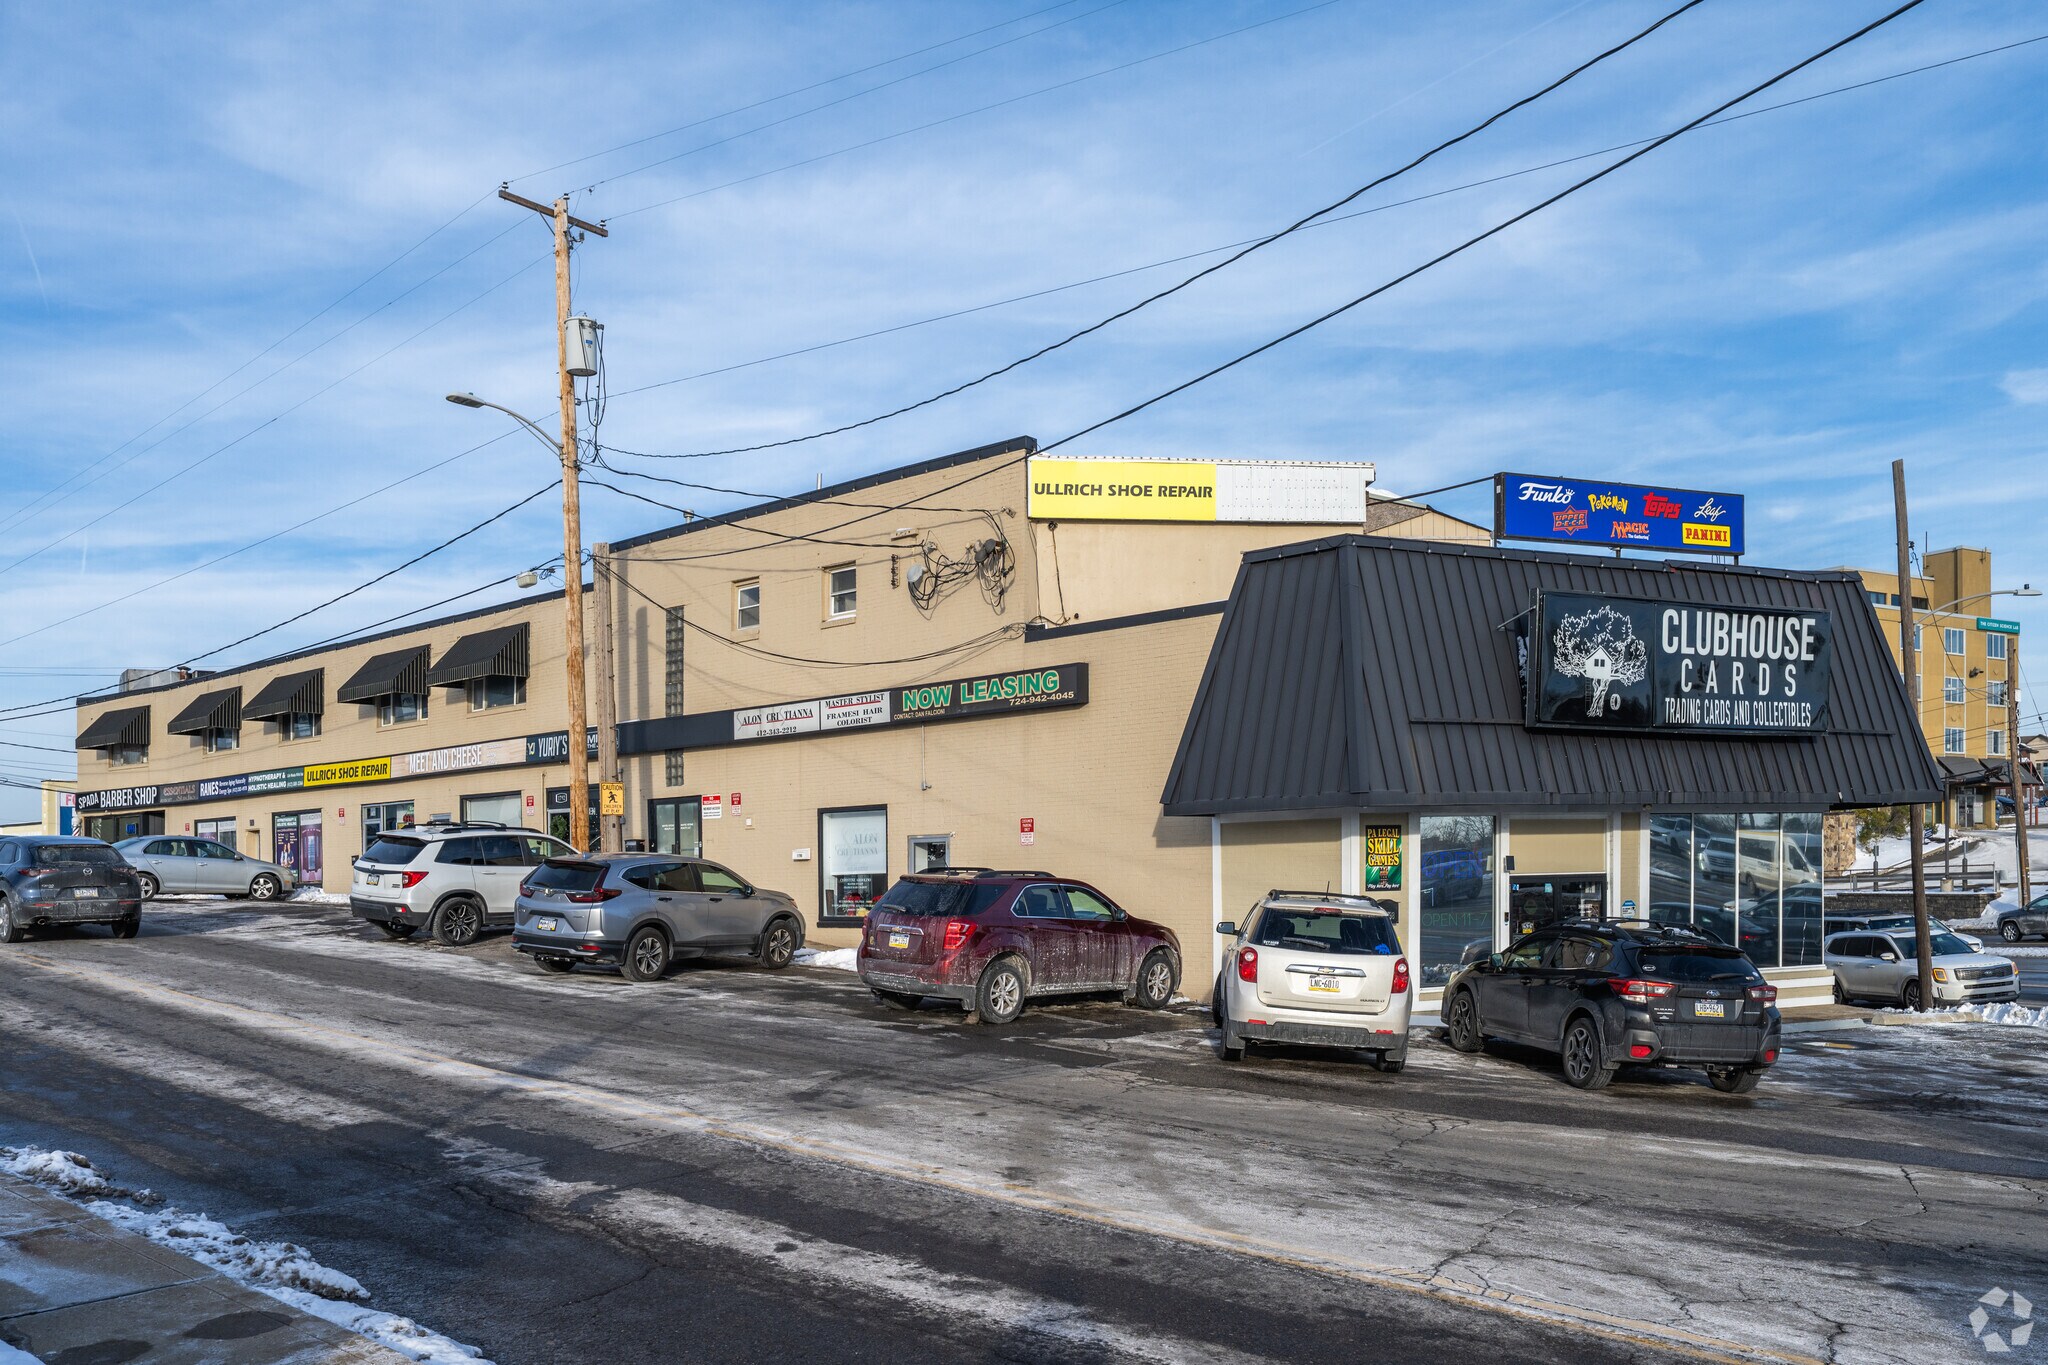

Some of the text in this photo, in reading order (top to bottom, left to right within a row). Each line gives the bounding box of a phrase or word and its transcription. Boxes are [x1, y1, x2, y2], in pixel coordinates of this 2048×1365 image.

[1034, 482, 1213, 498] ULLRICH SHOE REPAIR
[1518, 482, 1575, 504] Funko
[1694, 498, 1726, 522] Leaf
[1610, 522, 1649, 538] MAGIC
[1686, 528, 1728, 542] PANINI
[1662, 608, 1816, 660] CLUBHOUSE
[1680, 658, 1796, 696] CARDS
[902, 670, 1060, 712] NOW LEASING
[1009, 691, 1074, 706] 724-942-4045
[825, 693, 884, 708] MASTER STYLIST
[827, 707, 883, 720] FRAMESI HAIR
[1666, 698, 1811, 727] TRADING CARDS AND COLLECTIBLES
[837, 716, 872, 727] COLORIST
[538, 735, 568, 758] YURIY'S
[409, 752, 430, 774] MEET
[432, 750, 449, 770] AND
[451, 744, 482, 767] CHEESE
[307, 768, 337, 782] ULLRICH
[338, 766, 359, 779] SHOE
[361, 763, 388, 777] REPAIR
[200, 781, 218, 796] RANES
[78, 787, 158, 809] SPADA BARBER SHOP
[1368, 829, 1399, 838] PA LEGAL
[1368, 838, 1400, 854] SKILL
[1368, 854, 1400, 866] GAMES
[1422, 913, 1458, 927] OPEN
